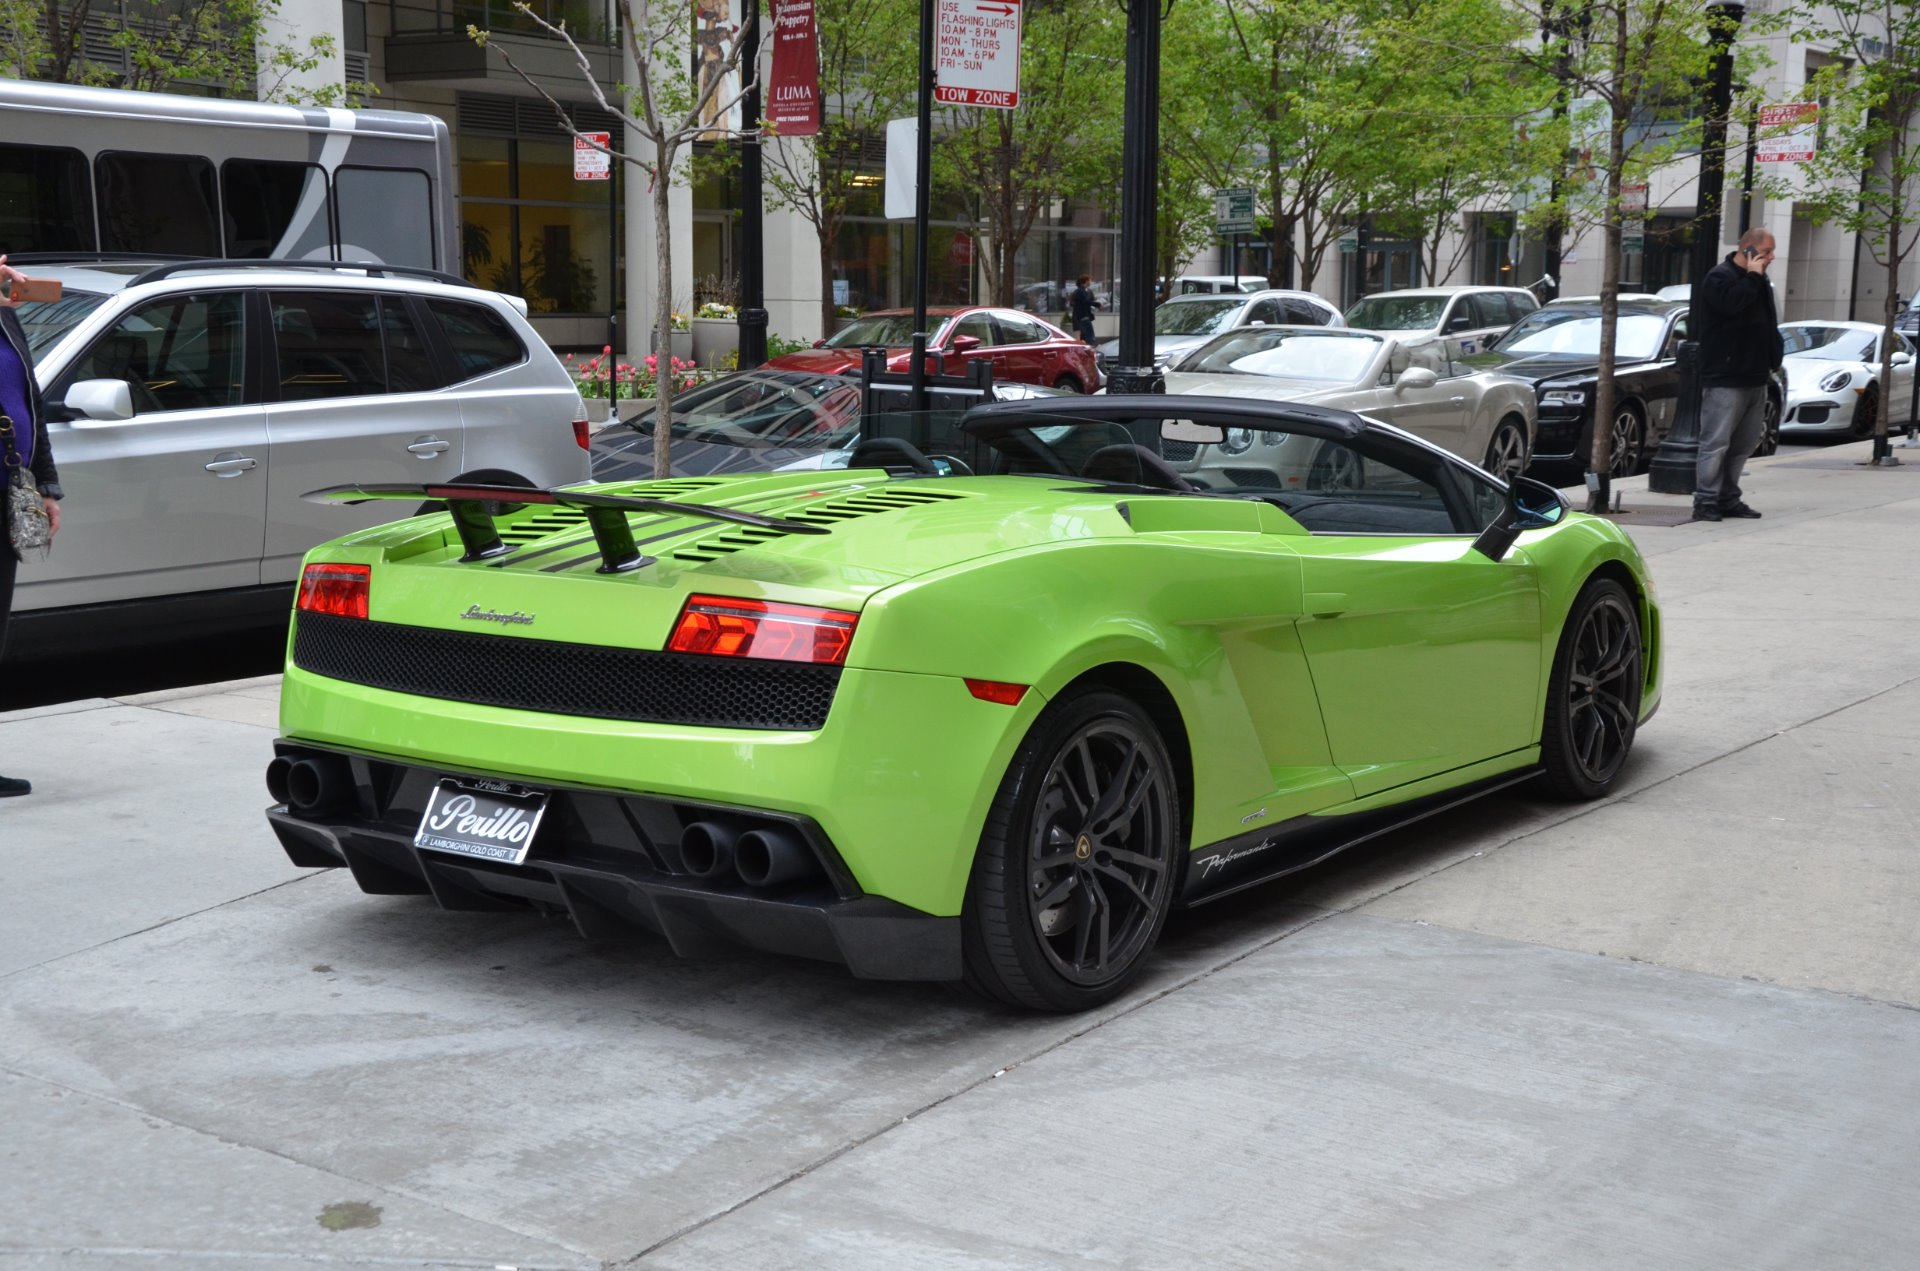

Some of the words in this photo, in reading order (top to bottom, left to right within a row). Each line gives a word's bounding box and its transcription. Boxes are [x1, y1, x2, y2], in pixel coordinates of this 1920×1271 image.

[942, 2, 959, 12] USE
[780, 14, 809, 28] Puppetry
[941, 13, 984, 27] FLASHING
[986, 18, 1015, 30] LIGHTS
[941, 24, 951, 34] 10
[953, 25, 966, 35] AM
[975, 27, 981, 37] 8
[983, 28, 997, 38] PM
[941, 35, 960, 46] MON
[971, 38, 1000, 50] THURS
[941, 46, 950, 56] 10
[951, 48, 964, 58] AM
[974, 50, 980, 60] 6
[982, 50, 995, 60] PM
[940, 58, 955, 68] FRI
[964, 60, 982, 70] SUN
[776, 85, 812, 100] LUMA
[940, 88, 968, 102] TOW
[975, 90, 1010, 105] ZONE
[475, 780, 512, 792] Perillo
[430, 794, 530, 842] Perillo
[430, 838, 470, 852] LAMBORGHINI
[470, 845, 486, 855] GOLD
[487, 848, 507, 858] COAST
